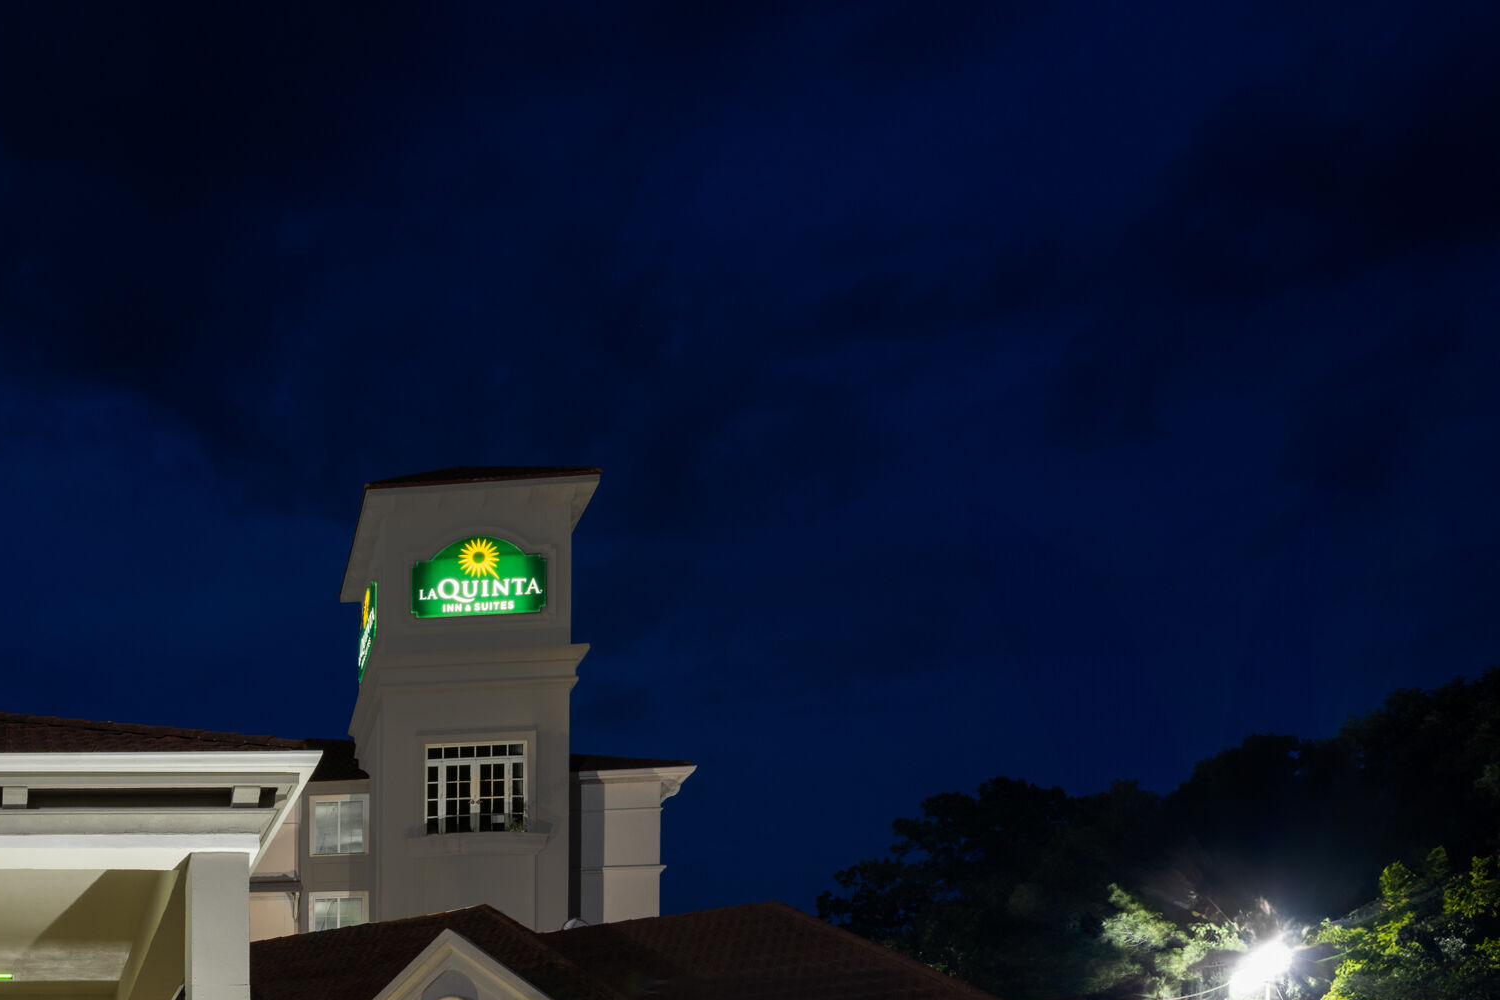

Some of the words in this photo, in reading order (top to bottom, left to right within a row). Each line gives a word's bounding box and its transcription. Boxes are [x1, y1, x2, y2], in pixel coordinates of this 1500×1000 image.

[419, 589, 438, 600] LA
[438, 577, 541, 603] QUINTA
[442, 603, 462, 613] INN
[465, 604, 472, 612] &
[474, 600, 515, 612] SUITES
